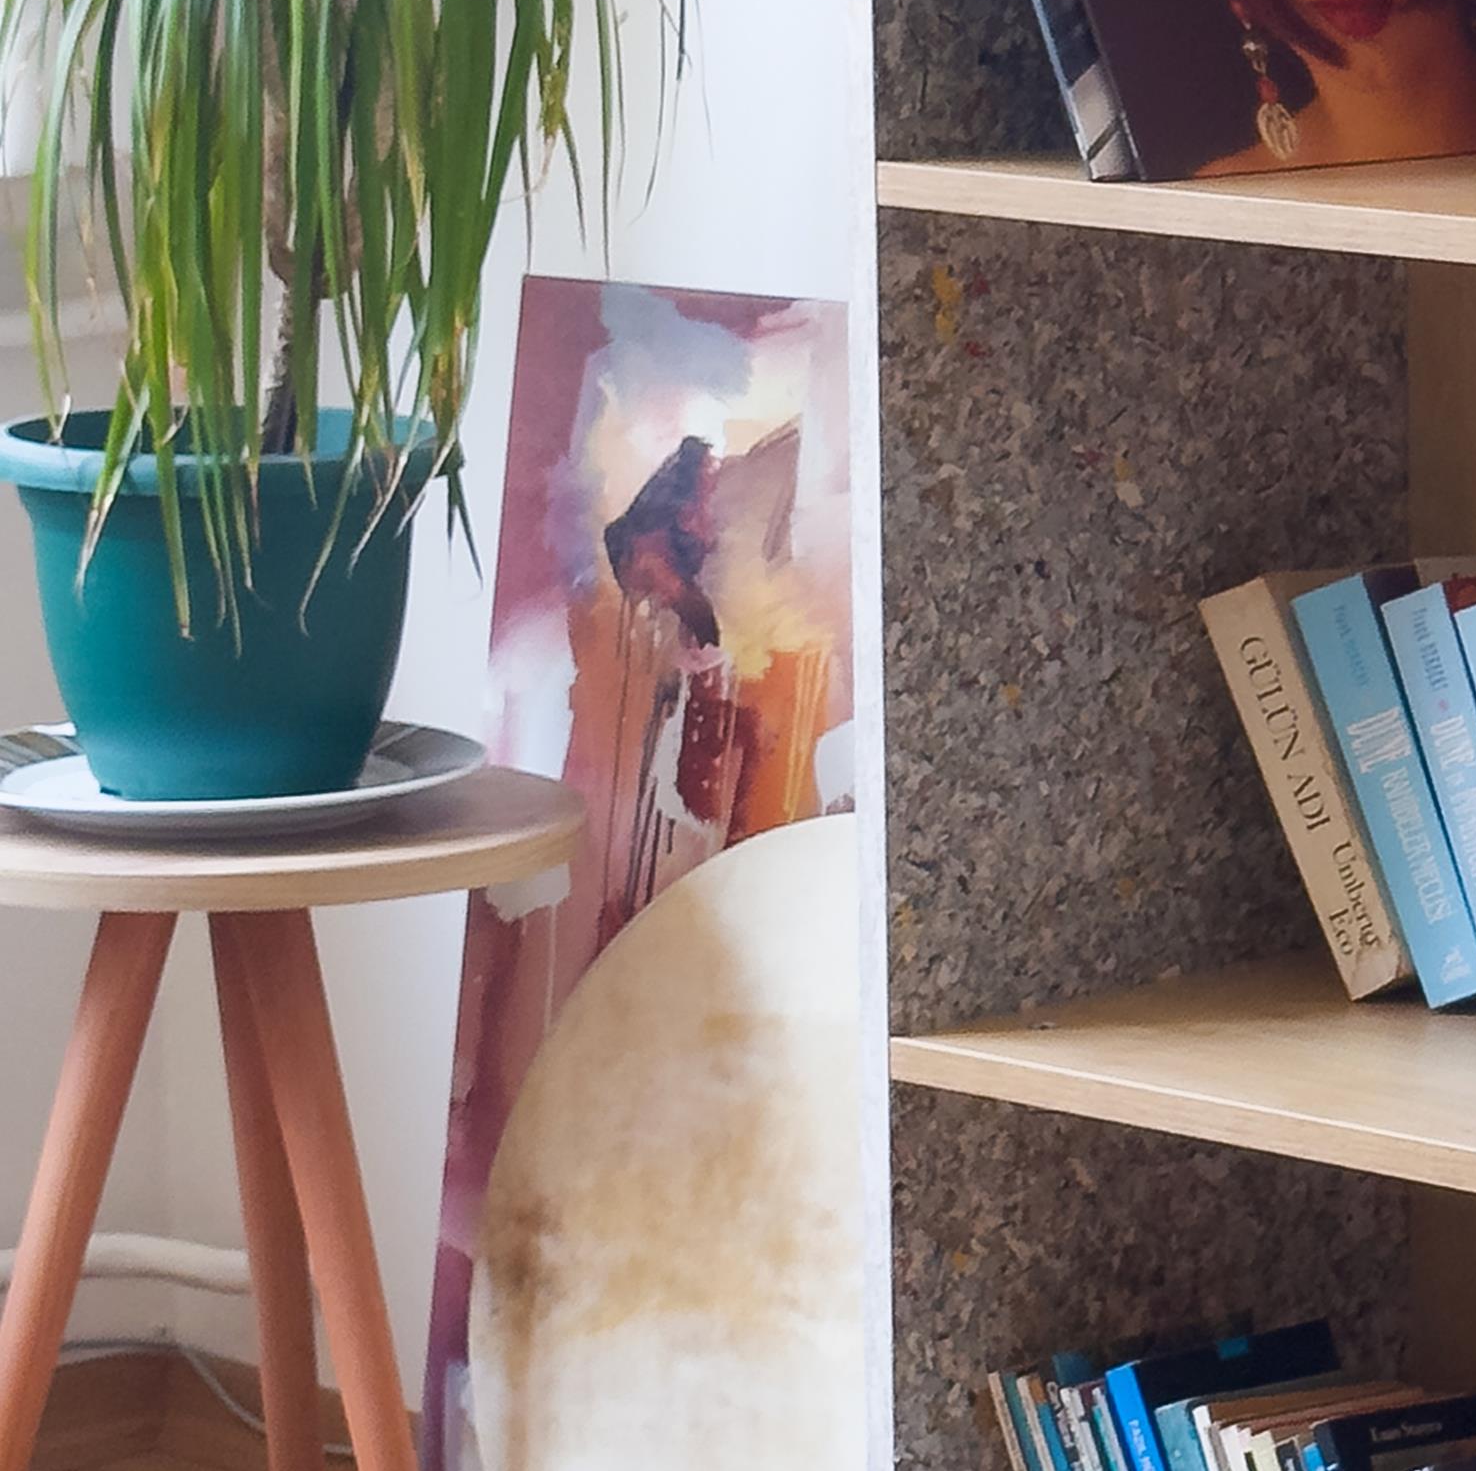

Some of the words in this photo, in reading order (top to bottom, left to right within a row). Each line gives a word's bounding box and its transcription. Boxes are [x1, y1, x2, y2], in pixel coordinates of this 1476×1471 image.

[1239, 635, 1304, 761] GÜLÜN
[1287, 772, 1330, 830] ADI
[1346, 705, 1412, 773] DUNE
[1328, 907, 1362, 955] Eco
